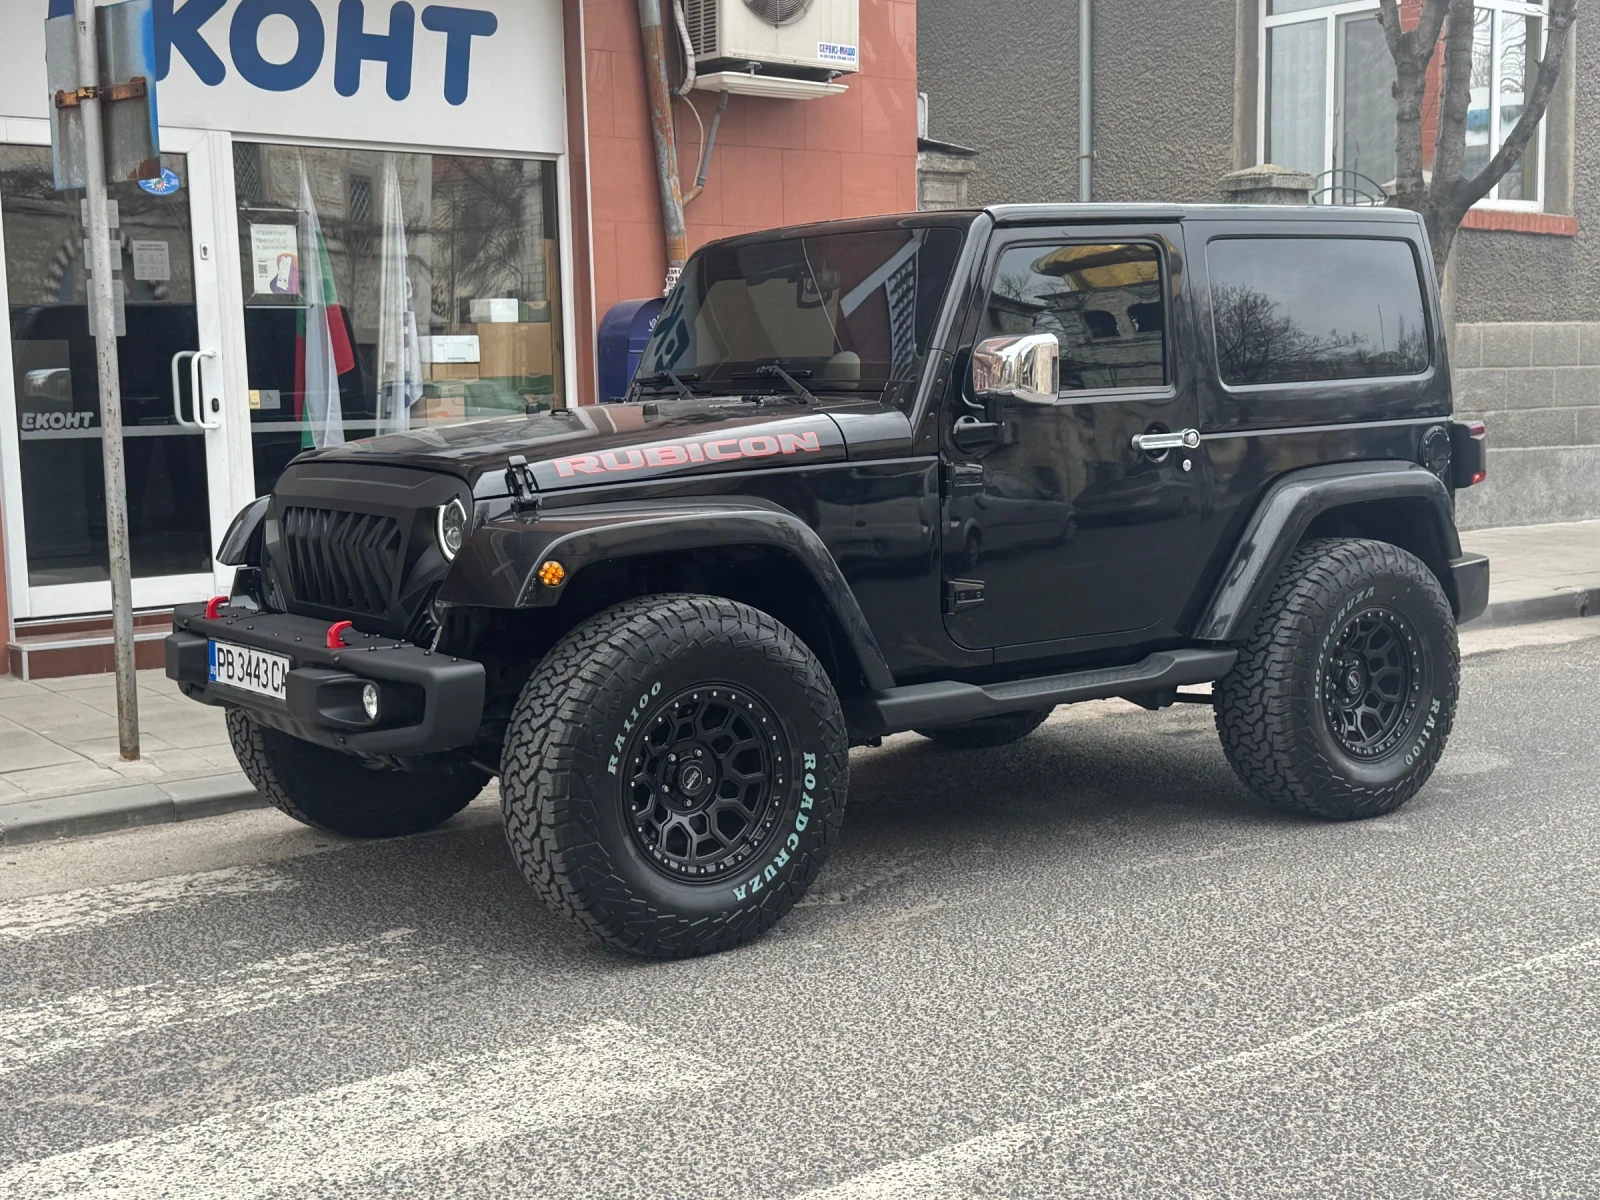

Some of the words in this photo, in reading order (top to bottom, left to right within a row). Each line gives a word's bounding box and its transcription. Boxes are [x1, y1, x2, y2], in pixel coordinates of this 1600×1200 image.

[48, 0, 499, 106] КОНТ
[21, 411, 95, 430] ЕКОНТ
[553, 431, 821, 478] RUBICON
[217, 647, 235, 680] PB
[237, 652, 269, 689] 3443
[1314, 586, 1375, 700] ROADCRUZA
[607, 681, 662, 775] RA1100
[1405, 698, 1441, 766] RA1100
[732, 752, 817, 901] ROADCRUZA
